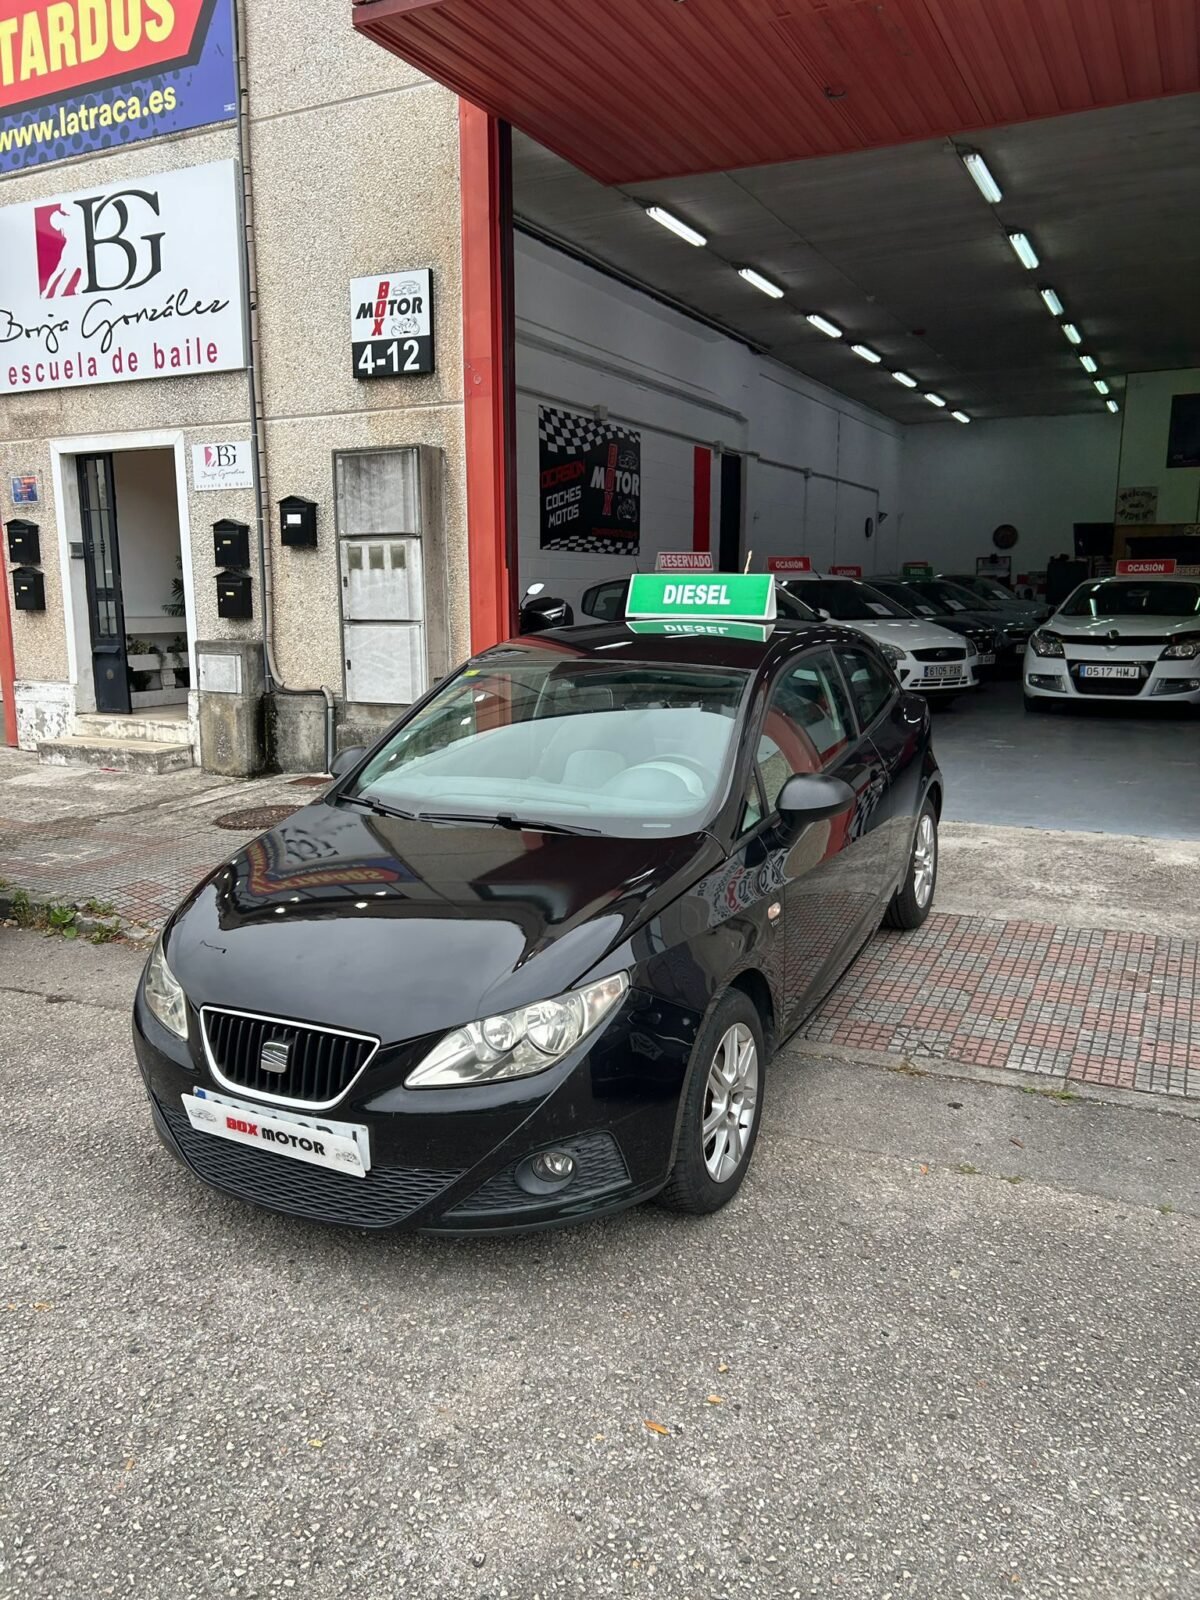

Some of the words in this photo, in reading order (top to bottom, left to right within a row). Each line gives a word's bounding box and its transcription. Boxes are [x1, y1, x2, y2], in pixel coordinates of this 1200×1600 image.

[0, 87, 176, 151] www.latraca.es
[73, 189, 166, 294] BG
[0, 309, 70, 353] Borja
[81, 288, 229, 353] González
[371, 281, 390, 336] BOX
[8, 352, 98, 385] escuela
[112, 347, 138, 373] de
[153, 337, 218, 369] baile
[358, 339, 420, 375] 4-12
[215, 444, 237, 466] BG
[545, 485, 582, 511] COCHES
[548, 504, 580, 529] MOTOS
[660, 554, 711, 569] RESERVADO
[775, 560, 804, 569] OCASIÓN
[1127, 562, 1165, 572] OCASIÓN
[662, 584, 732, 605] DIESEL
[1086, 667, 1112, 677] 0517
[1116, 667, 1137, 678] HMJ
[226, 1116, 258, 1137] BOX
